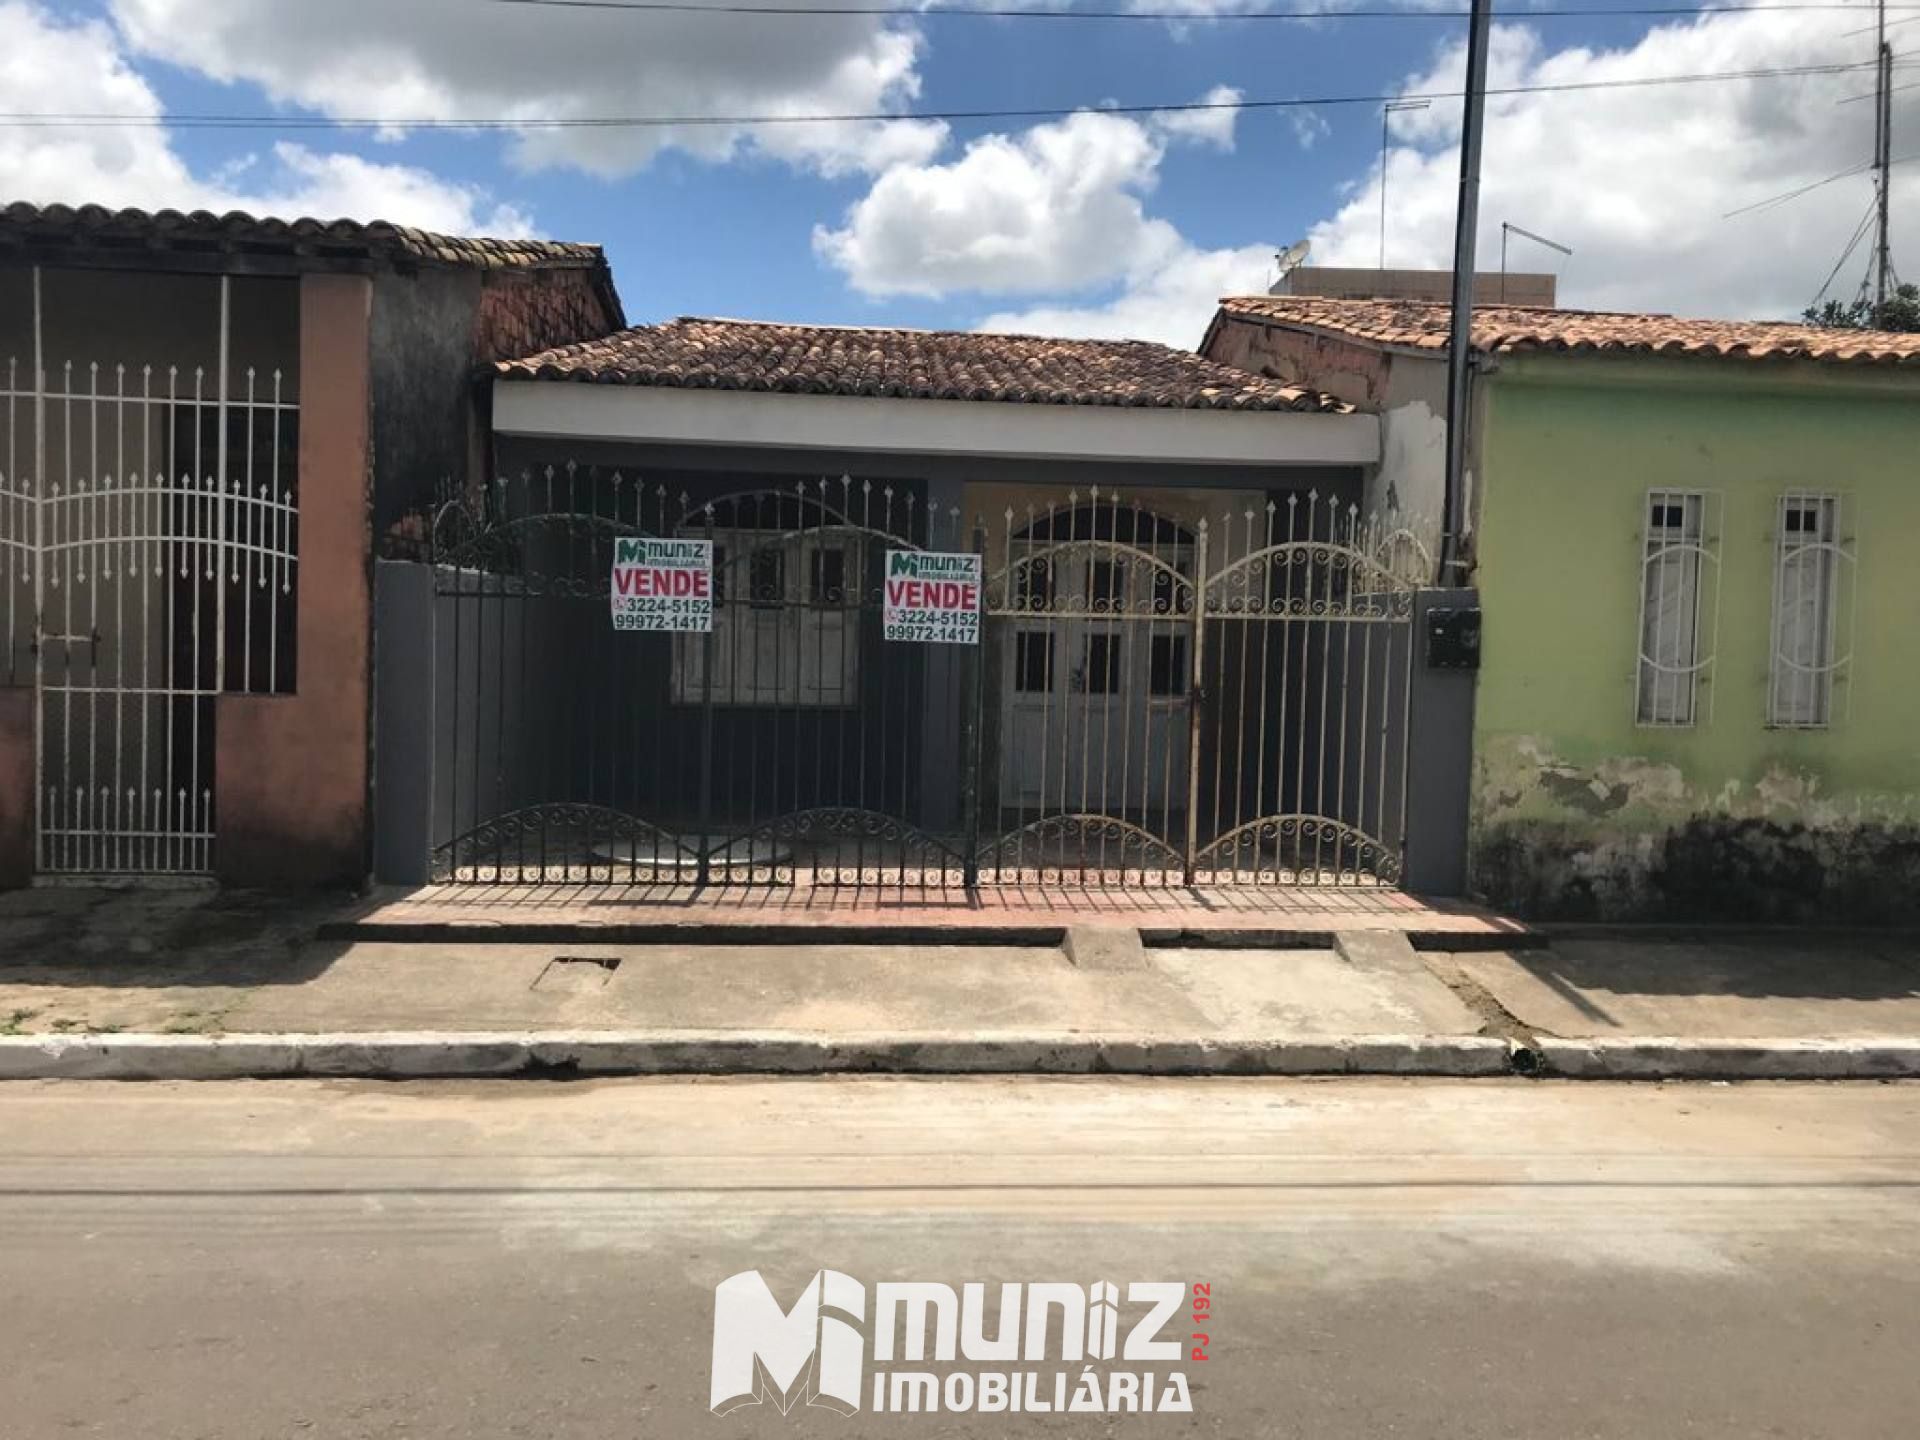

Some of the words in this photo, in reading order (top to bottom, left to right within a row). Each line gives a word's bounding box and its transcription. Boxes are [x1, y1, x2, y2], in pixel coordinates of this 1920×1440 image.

[614, 568, 708, 597] VENDE
[887, 580, 976, 610] VENDE
[627, 598, 710, 613] 3224-5152
[616, 614, 708, 630] 99972-1417
[898, 609, 977, 626] 3224-5152
[886, 625, 975, 642] 99972-1417
